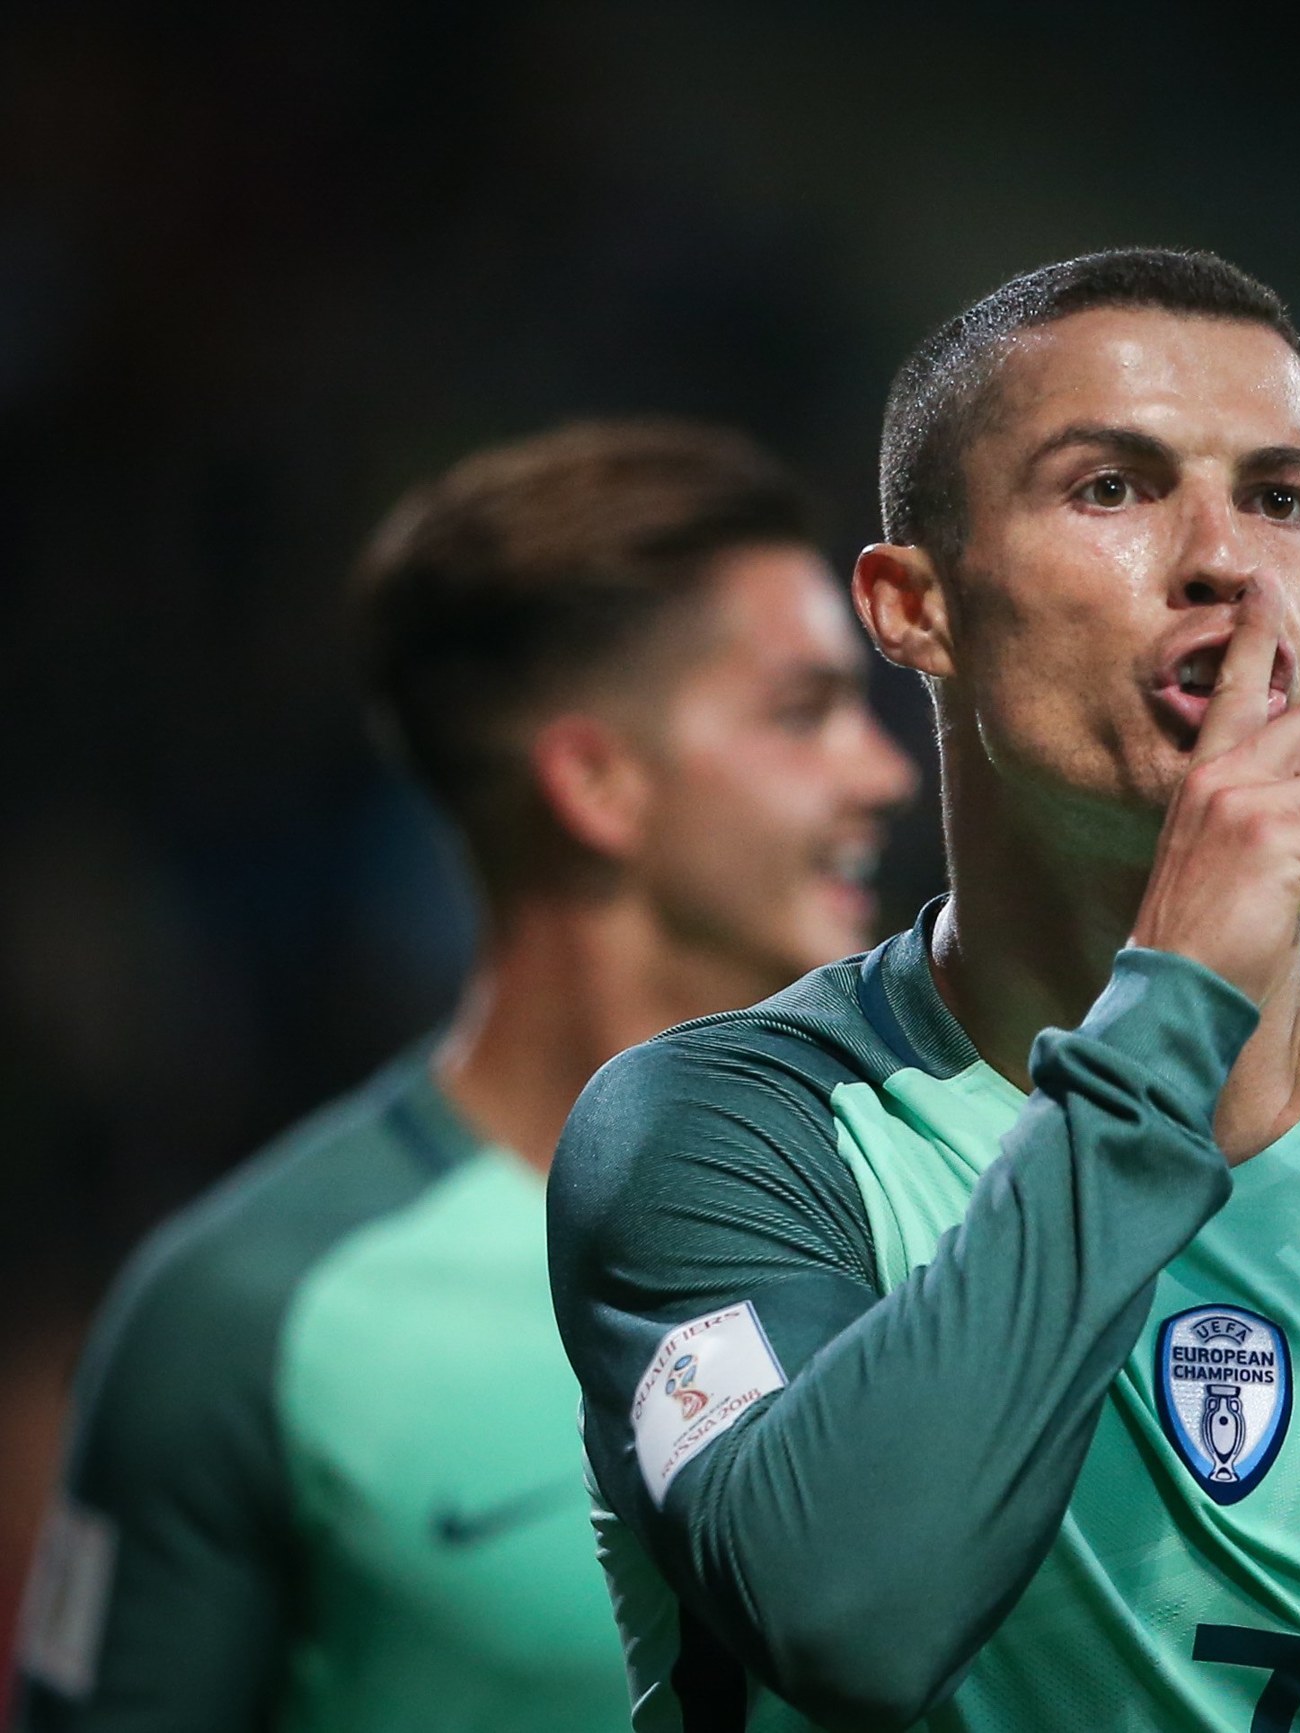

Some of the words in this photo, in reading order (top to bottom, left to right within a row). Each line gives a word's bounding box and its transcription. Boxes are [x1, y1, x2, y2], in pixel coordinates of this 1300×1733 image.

[1196, 1321, 1248, 1342] UEFA
[634, 1312, 740, 1420] QUALIFIERS
[1172, 1346, 1275, 1367] EUROPEAN
[1173, 1364, 1275, 1384] CHAMPIONS
[661, 1419, 717, 1479] RUSSIA
[720, 1388, 762, 1420] 2018
